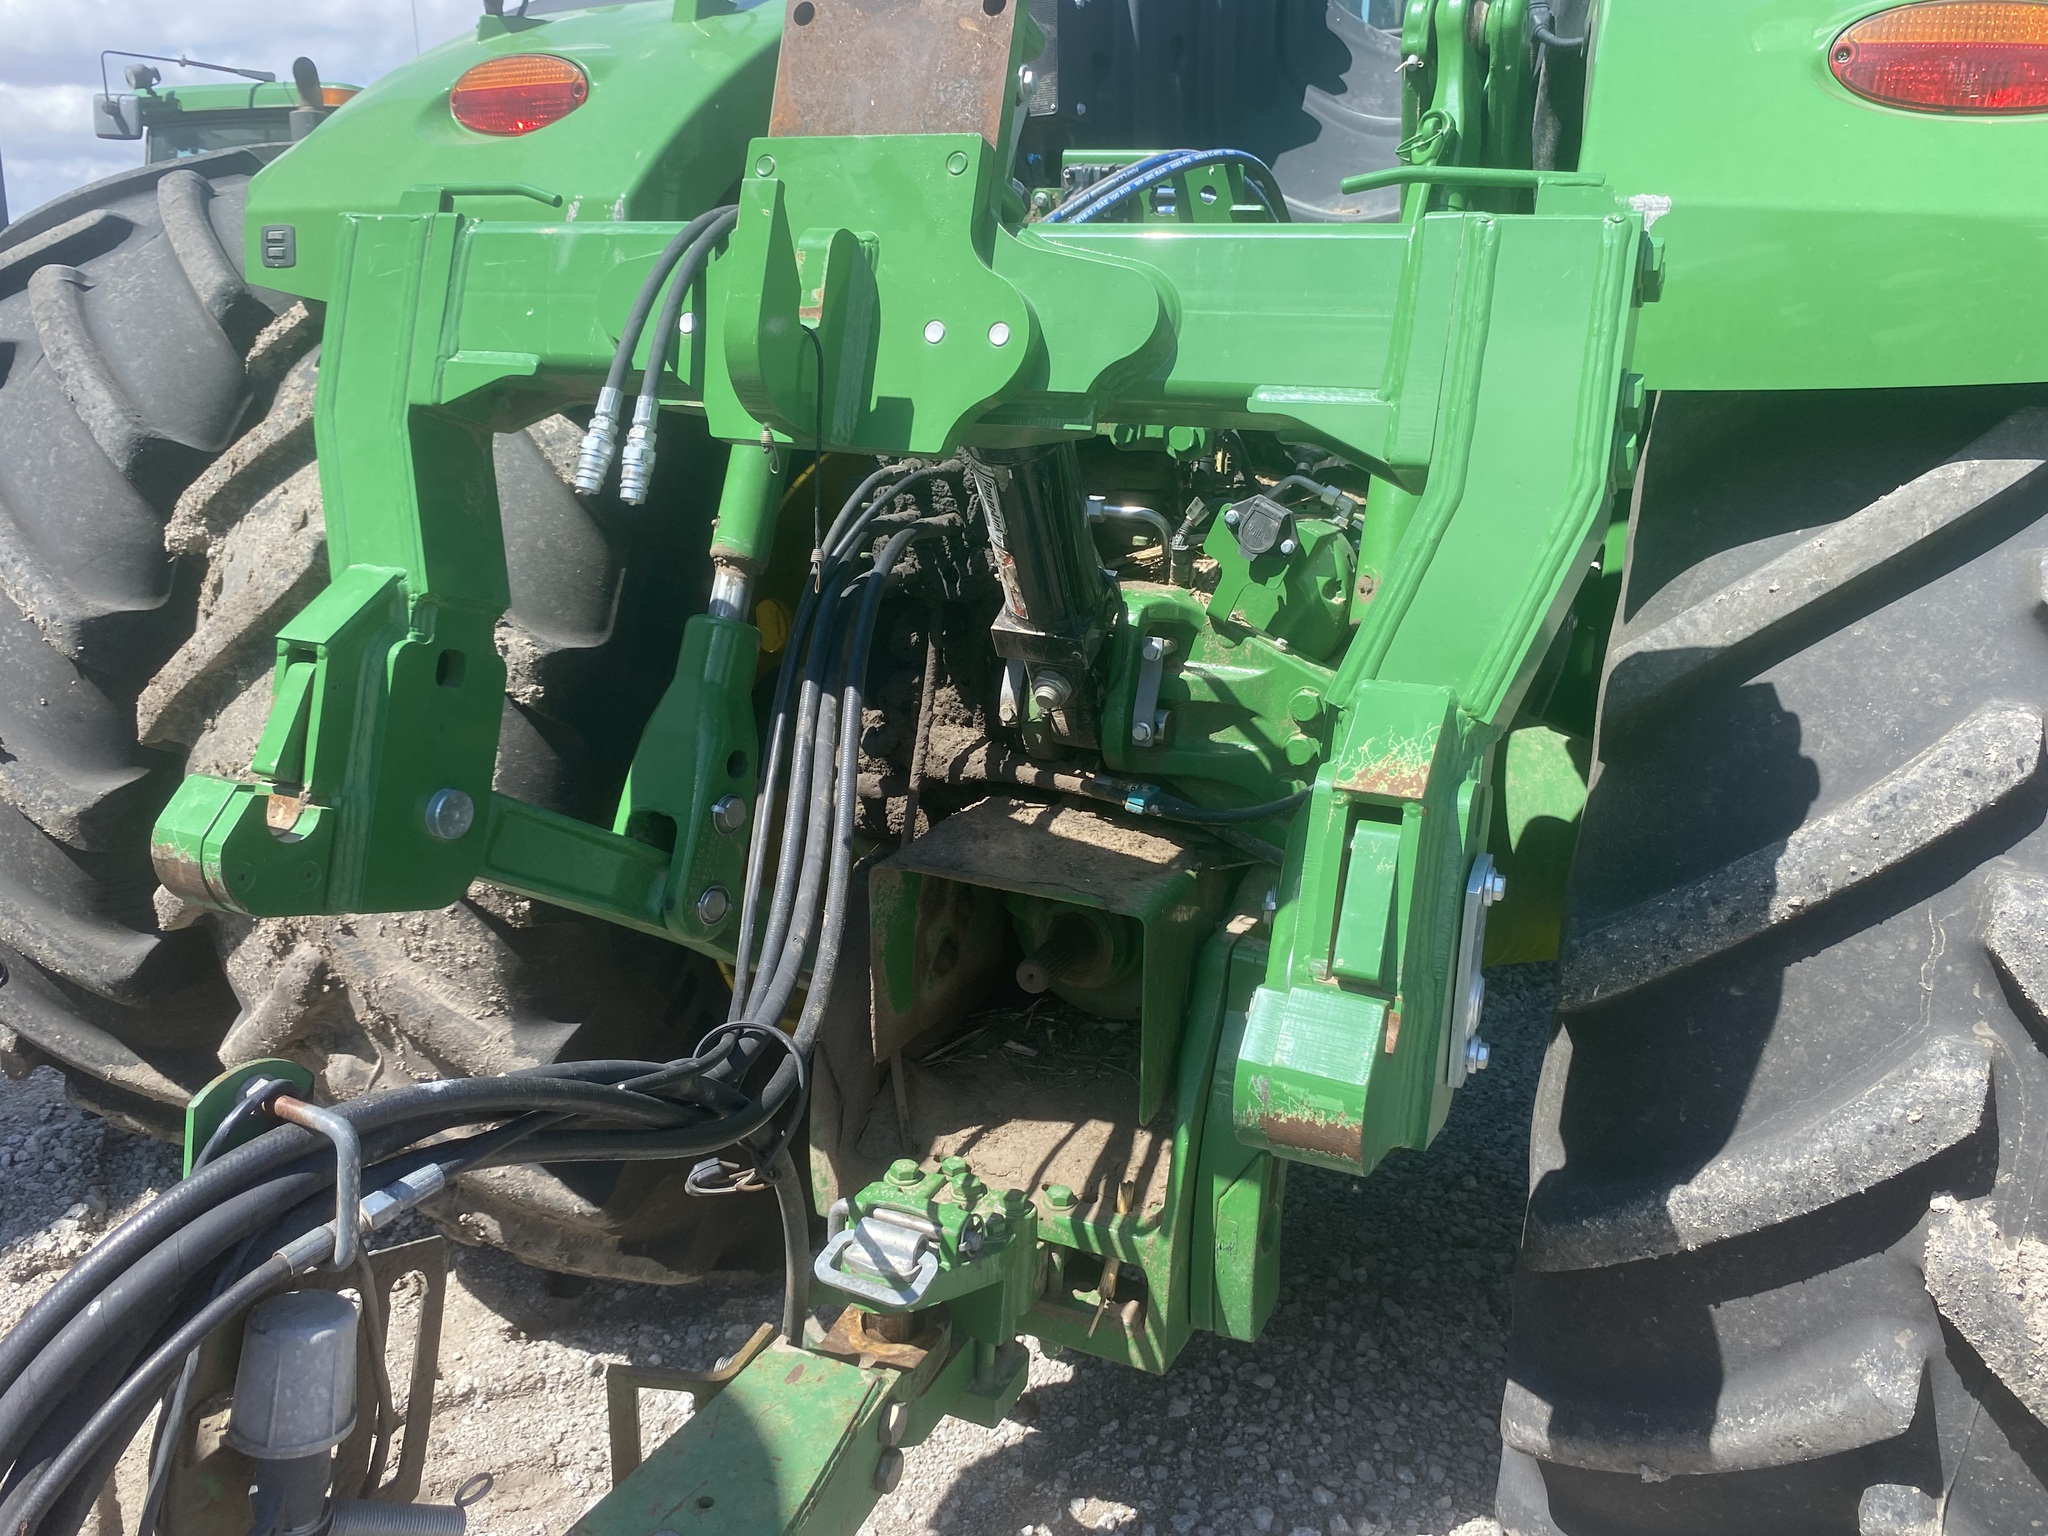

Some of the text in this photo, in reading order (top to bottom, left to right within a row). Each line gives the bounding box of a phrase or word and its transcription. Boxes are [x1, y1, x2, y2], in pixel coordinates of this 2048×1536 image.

[1109, 192, 1120, 202] 100
[1133, 178, 1144, 187] WP
[1154, 167, 1167, 177] BAR
